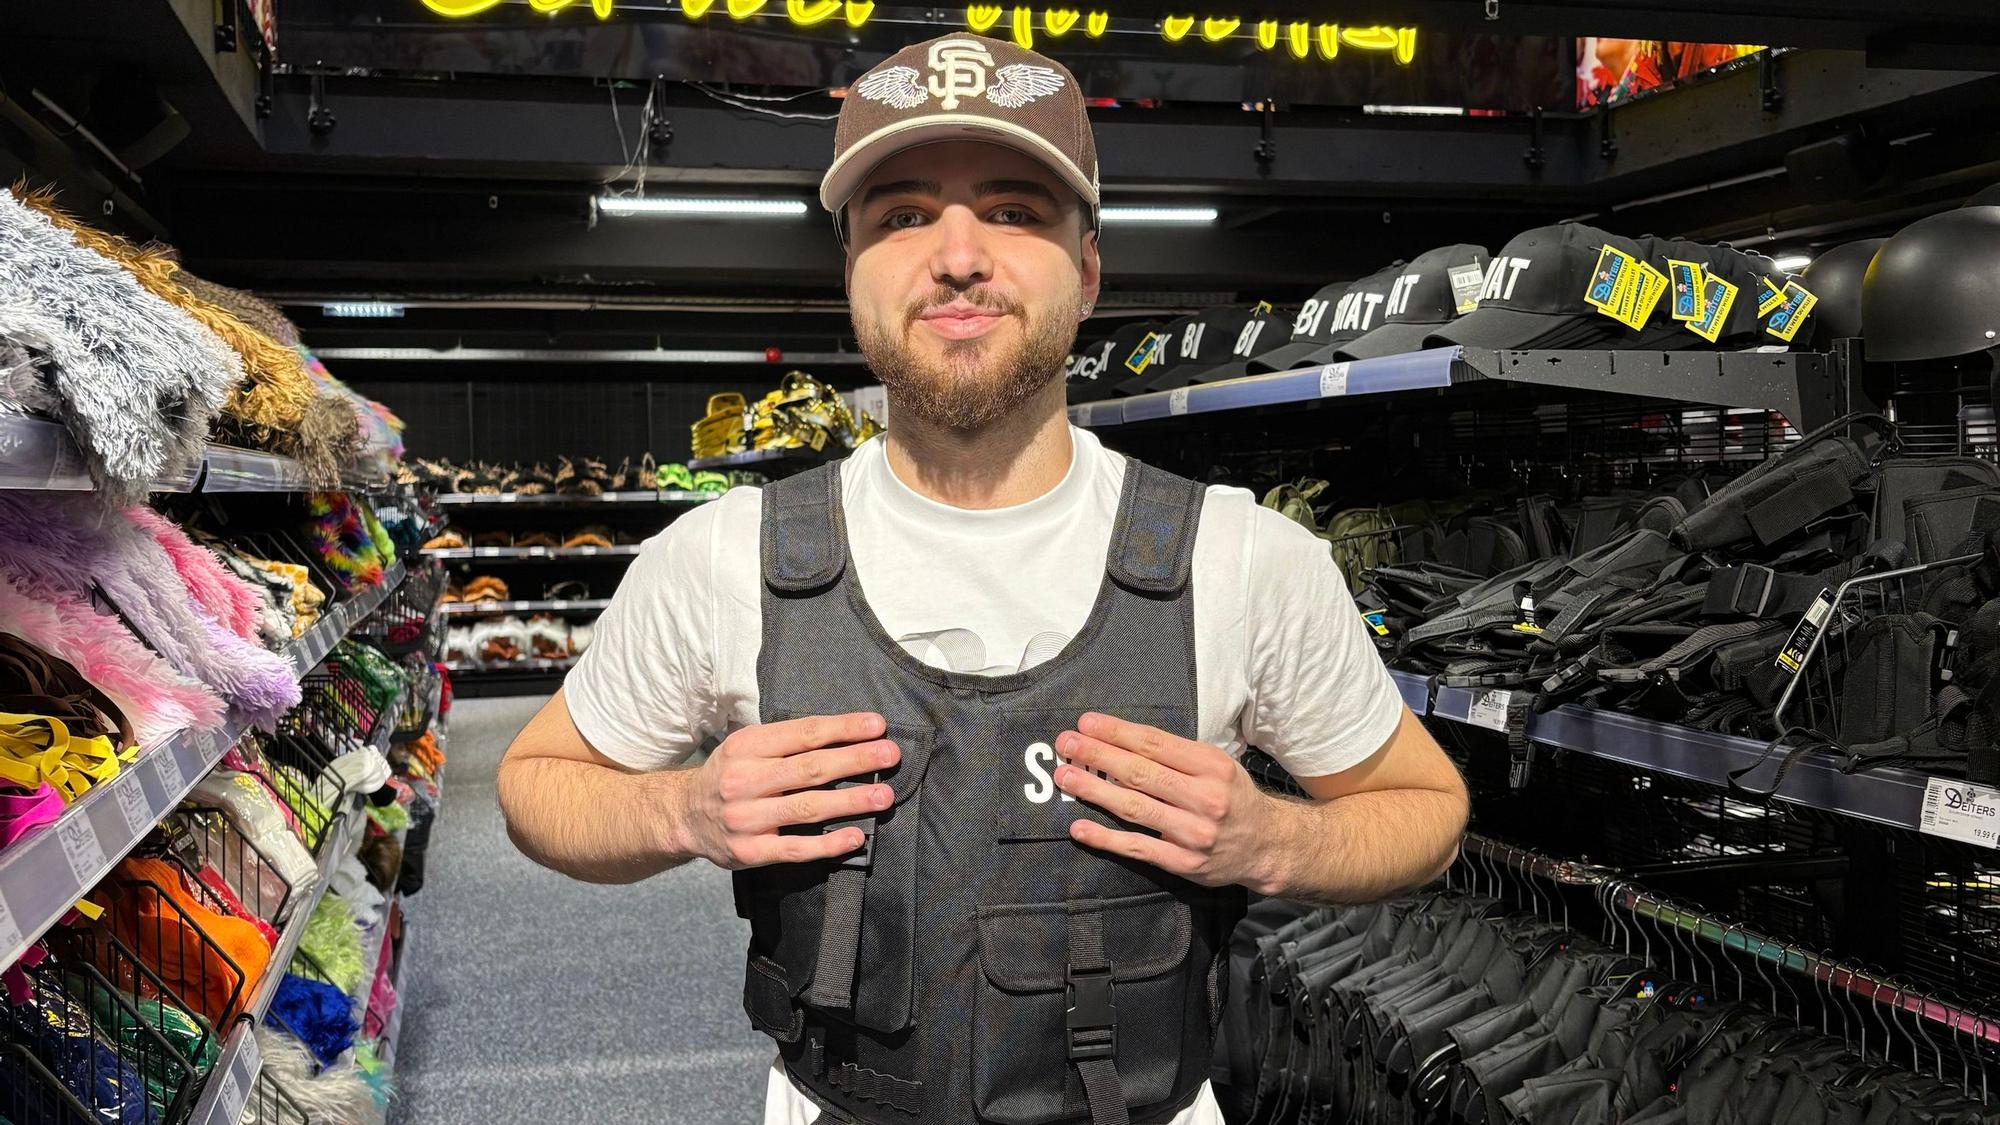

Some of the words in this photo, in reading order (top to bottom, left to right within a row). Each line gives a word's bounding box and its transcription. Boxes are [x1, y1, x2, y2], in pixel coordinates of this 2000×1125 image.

[1592, 256, 1622, 301] DEITERS
[1679, 267, 1693, 314] DEITERS
[1293, 299, 1329, 338] BI
[1769, 291, 1805, 329] DEITERS
[1945, 787, 1996, 817] DEITERS
